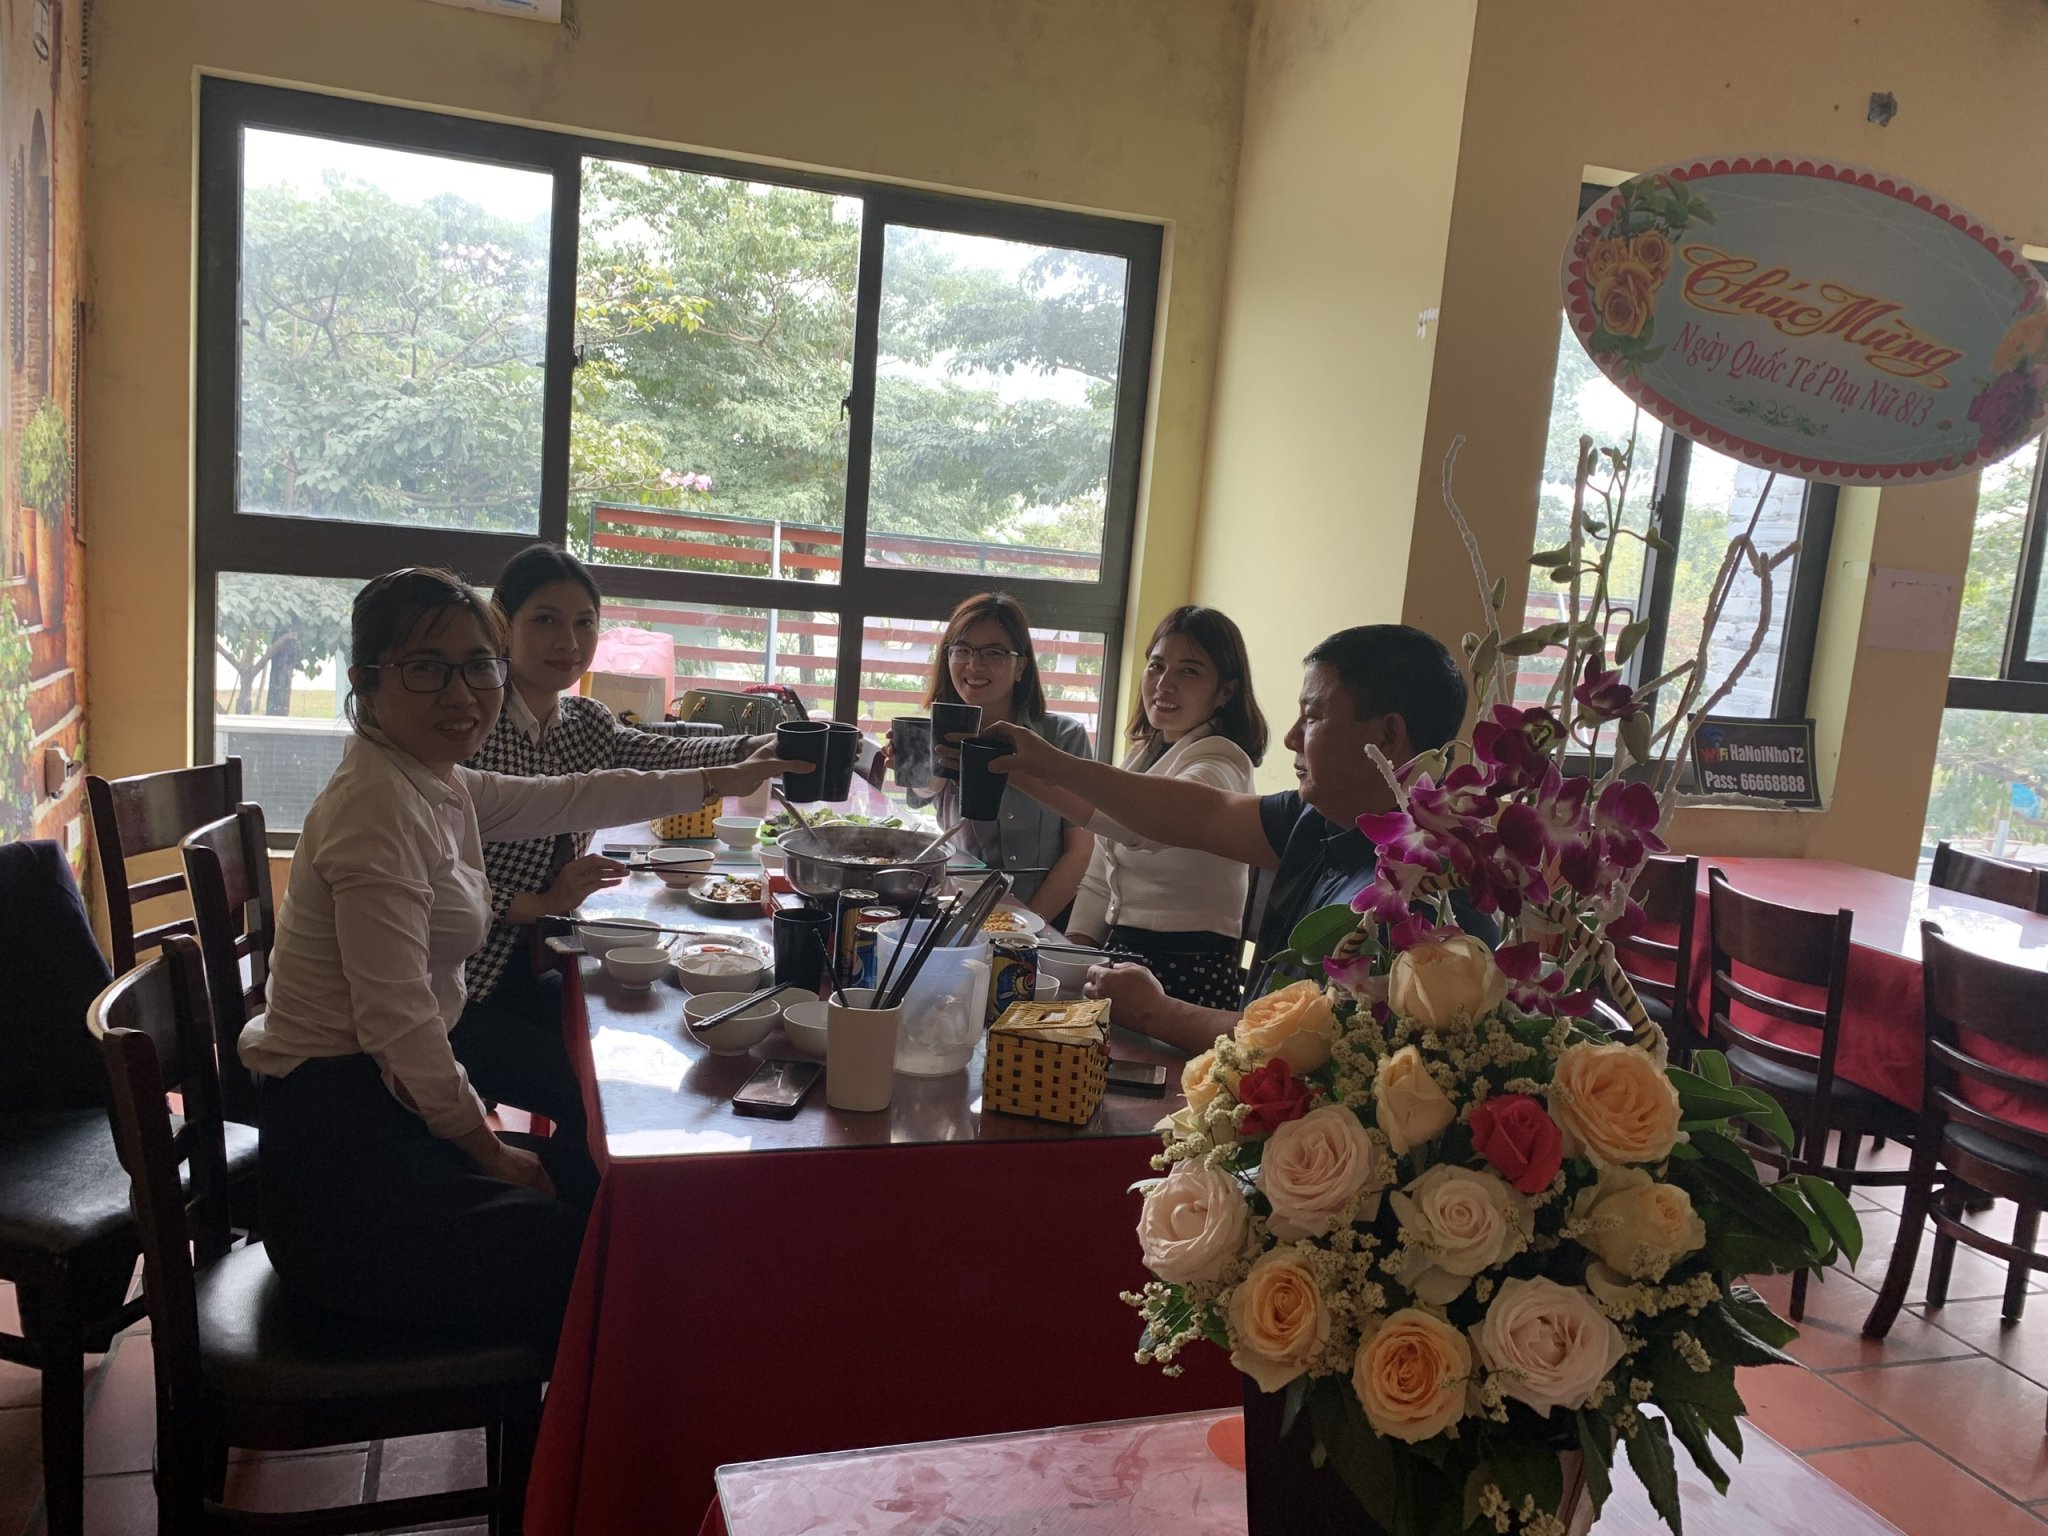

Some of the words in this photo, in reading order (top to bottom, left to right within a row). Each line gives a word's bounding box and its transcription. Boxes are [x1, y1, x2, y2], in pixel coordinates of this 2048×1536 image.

[1683, 246, 1823, 327] Chúc
[1774, 283, 1964, 390] Mừng
[1672, 320, 1729, 372] Ngày
[1727, 340, 1788, 381] Quốc
[1786, 356, 1828, 393] Tế
[1815, 366, 1861, 414] Phụ
[1859, 379, 1901, 418] Nữ
[1896, 390, 1935, 428] 8/3
[1705, 770, 1738, 790] Pass:
[1740, 773, 1805, 793] 66668888
[1729, 744, 1804, 764] HaNoiNhoT2
